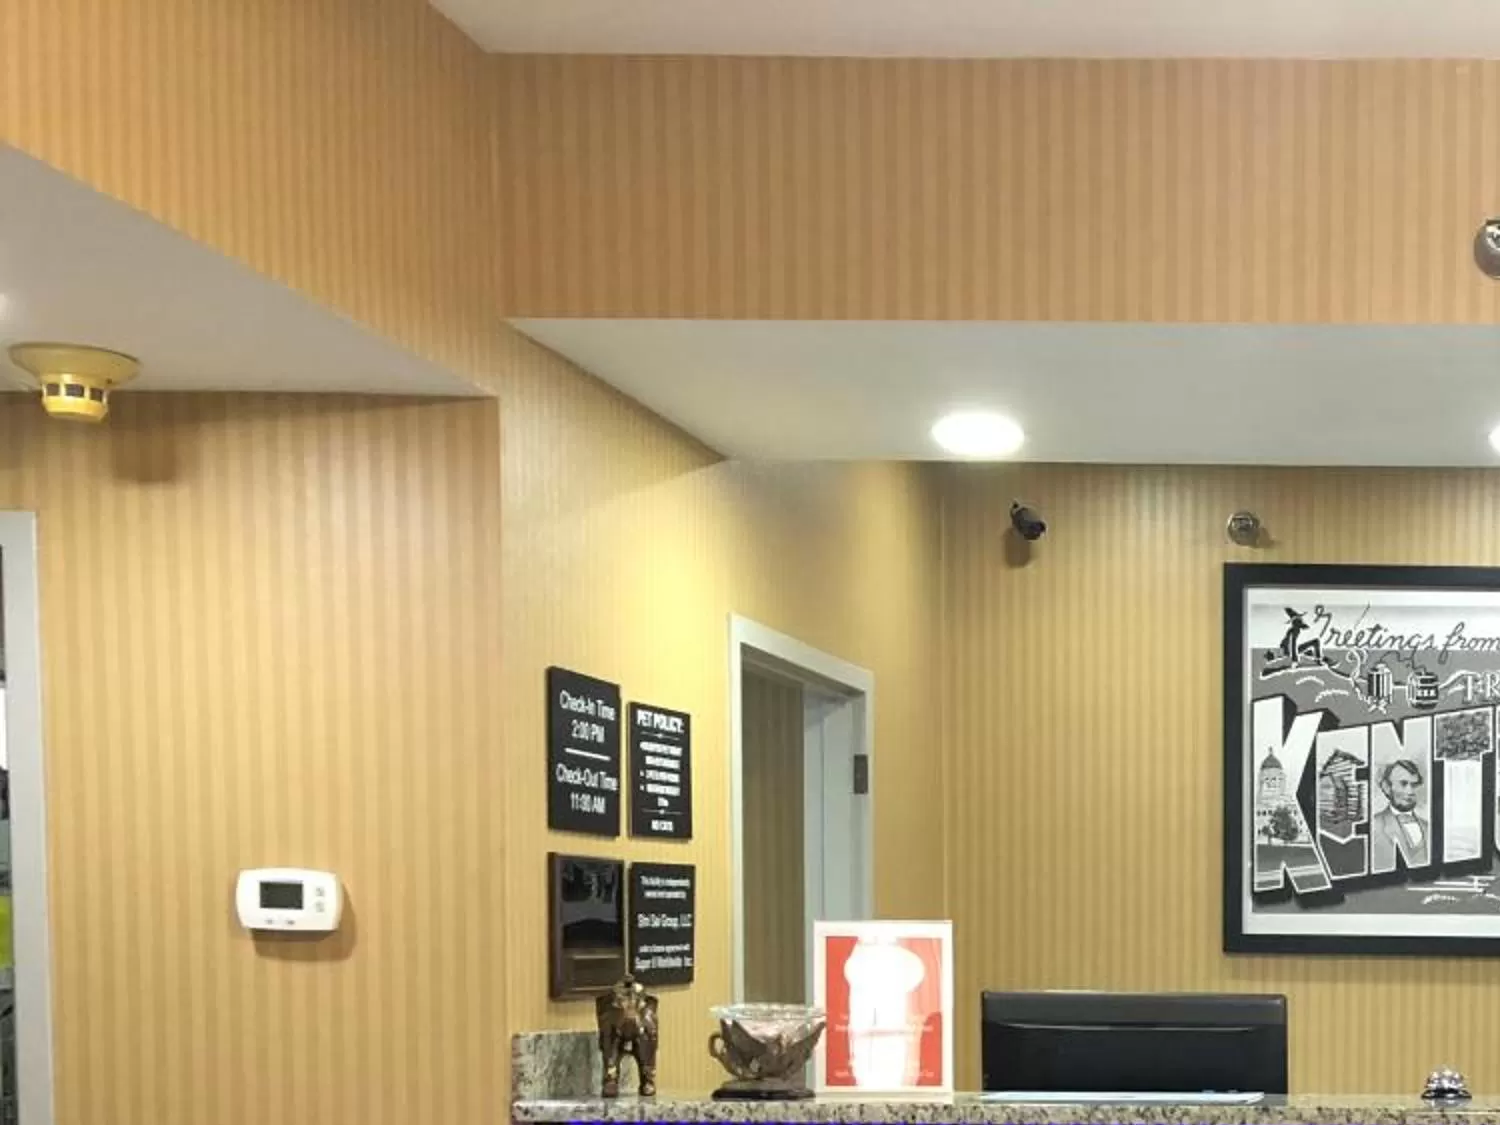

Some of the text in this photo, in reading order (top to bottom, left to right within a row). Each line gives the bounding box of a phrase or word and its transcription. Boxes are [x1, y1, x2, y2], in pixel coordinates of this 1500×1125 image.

[1313, 603, 1438, 653] Greetings
[559, 690, 616, 721] Check-In Time
[636, 709, 653, 727] PET
[591, 723, 605, 743] PM
[556, 763, 598, 789] Check-Out
[599, 771, 618, 791] Time
[592, 795, 606, 814] AM
